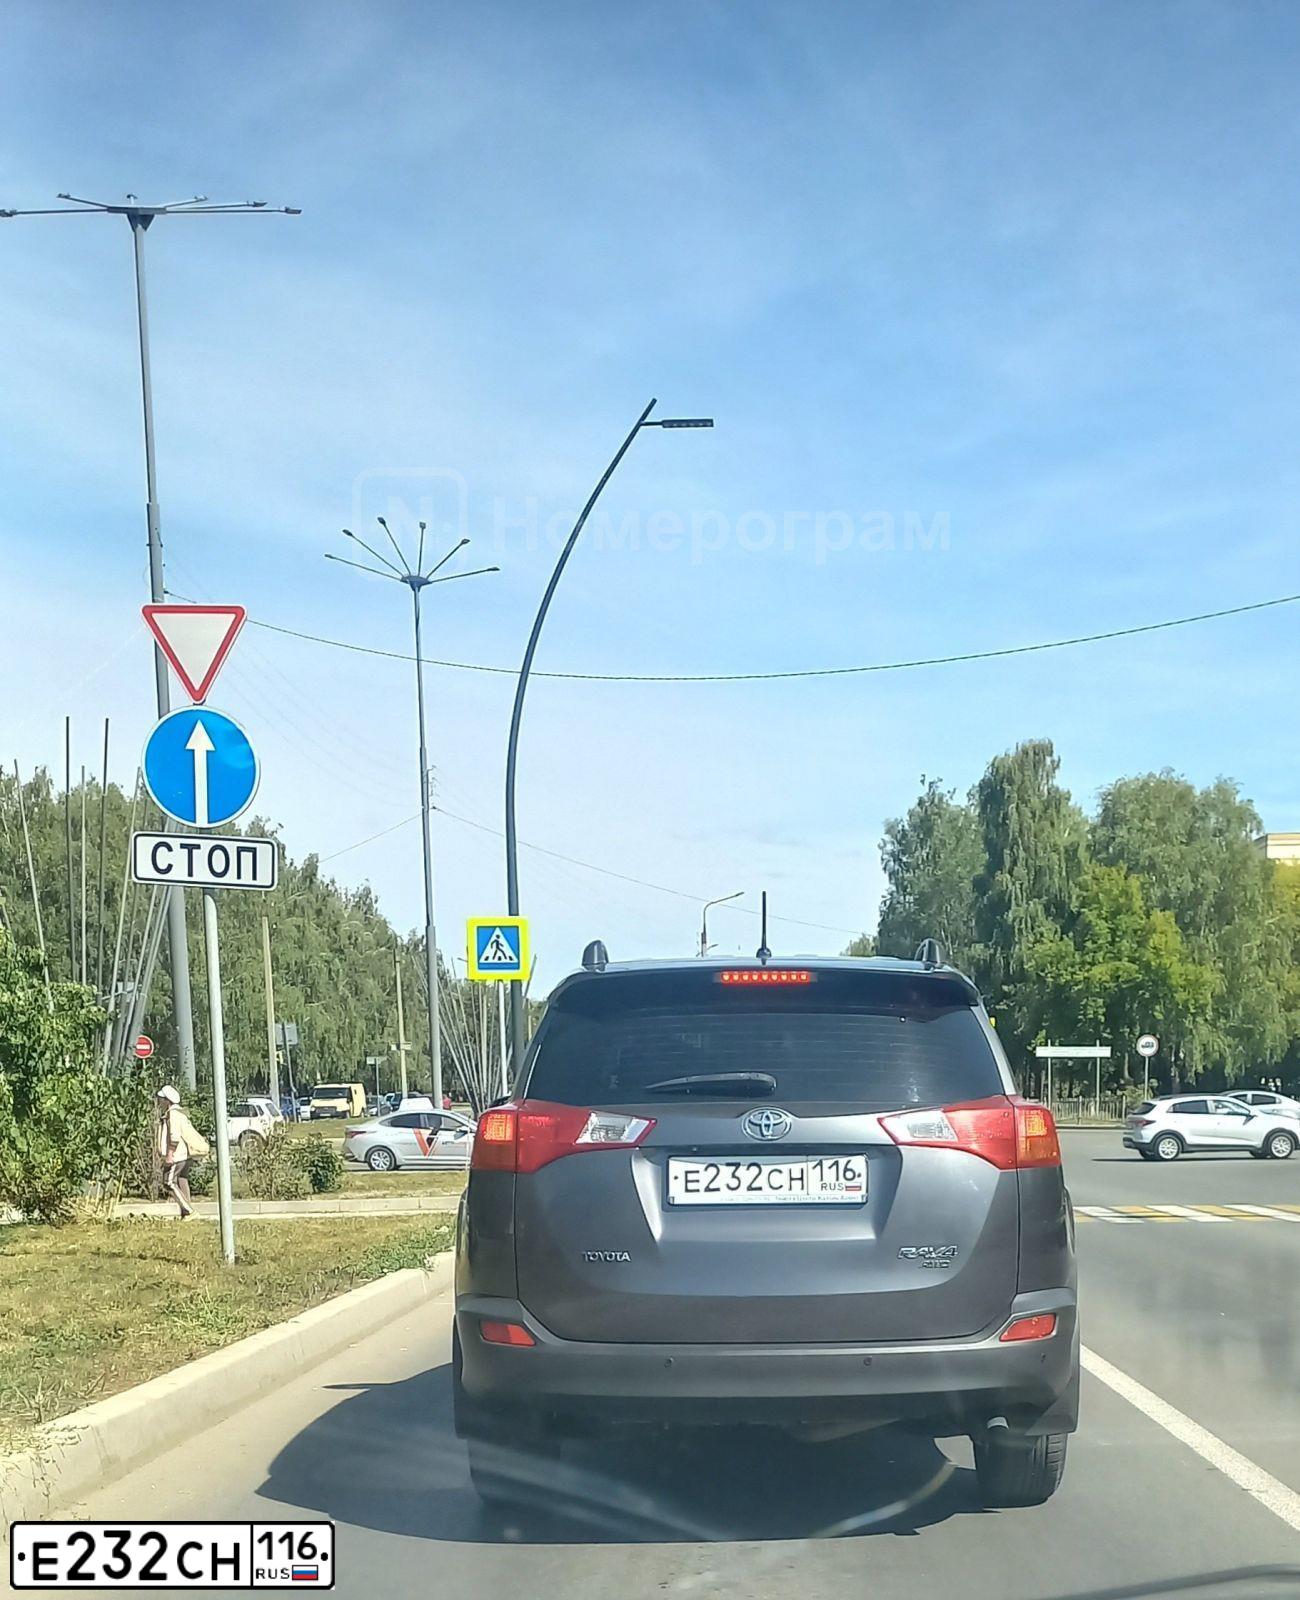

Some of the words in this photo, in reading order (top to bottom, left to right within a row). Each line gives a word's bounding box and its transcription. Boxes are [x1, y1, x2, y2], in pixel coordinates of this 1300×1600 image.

[151, 841, 258, 881] СТОП
[684, 1162, 805, 1193] Е232СН
[812, 1159, 857, 1182] 116
[820, 1182, 845, 1192] RUS
[582, 1250, 632, 1262] TOYOTA
[898, 1245, 959, 1259] RAV4
